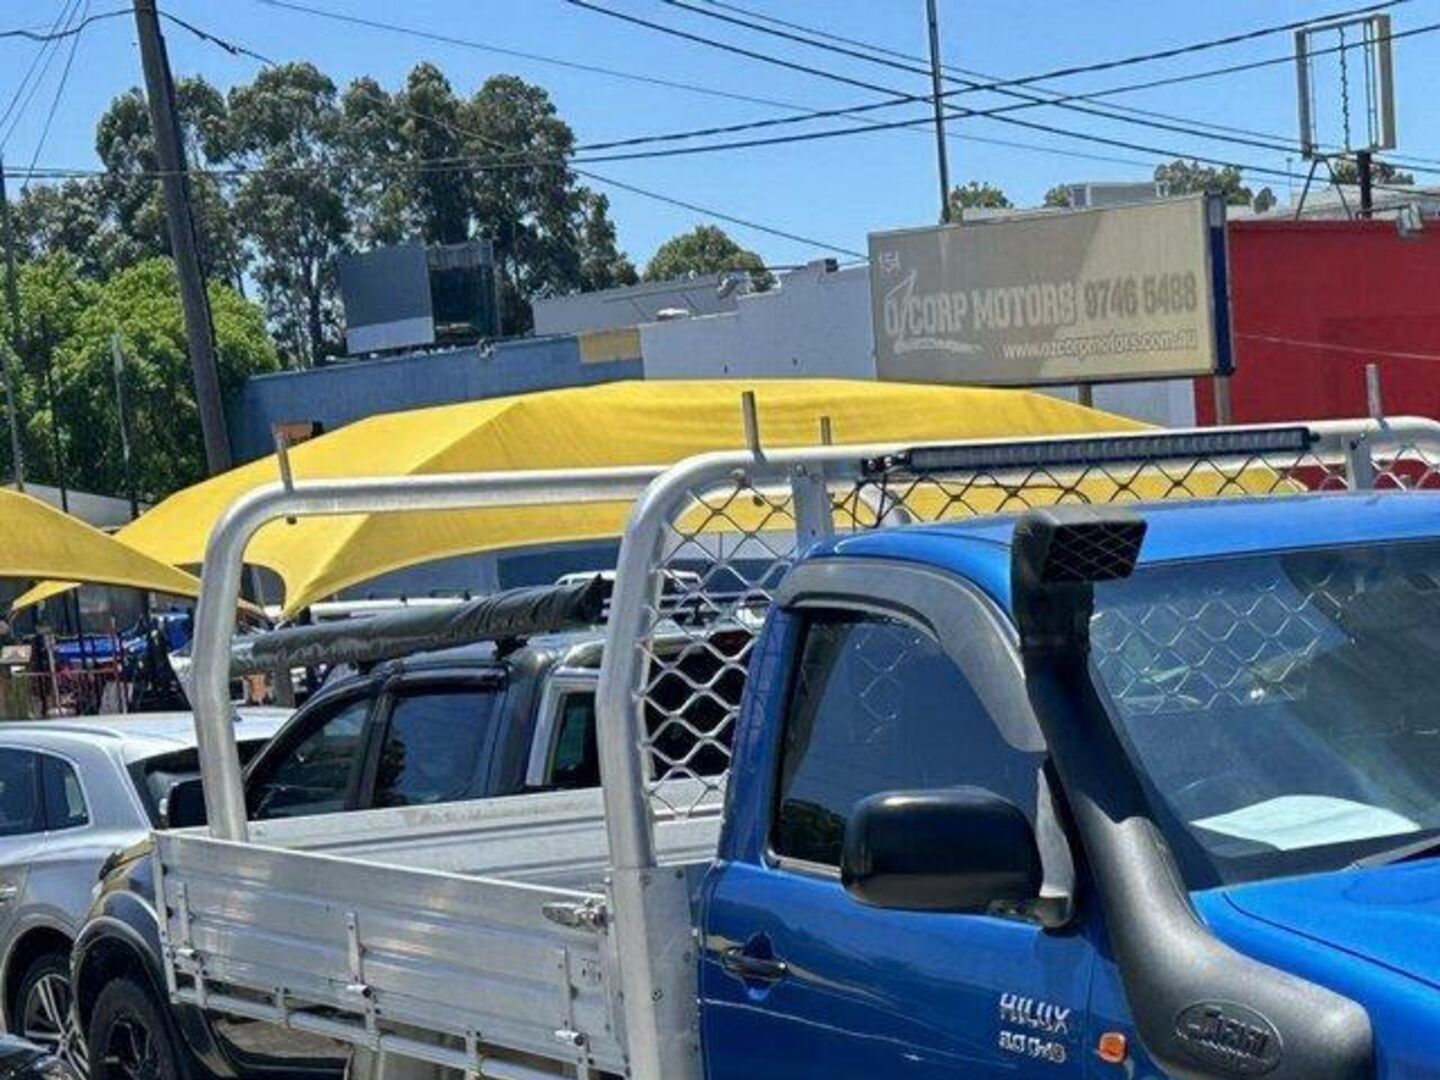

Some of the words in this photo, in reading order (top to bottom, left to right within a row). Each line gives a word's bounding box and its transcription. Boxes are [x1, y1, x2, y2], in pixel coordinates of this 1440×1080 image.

[971, 281, 1077, 331] MOTORS
[1084, 276, 1138, 319] 9746
[999, 993, 1070, 1035] HILUX
